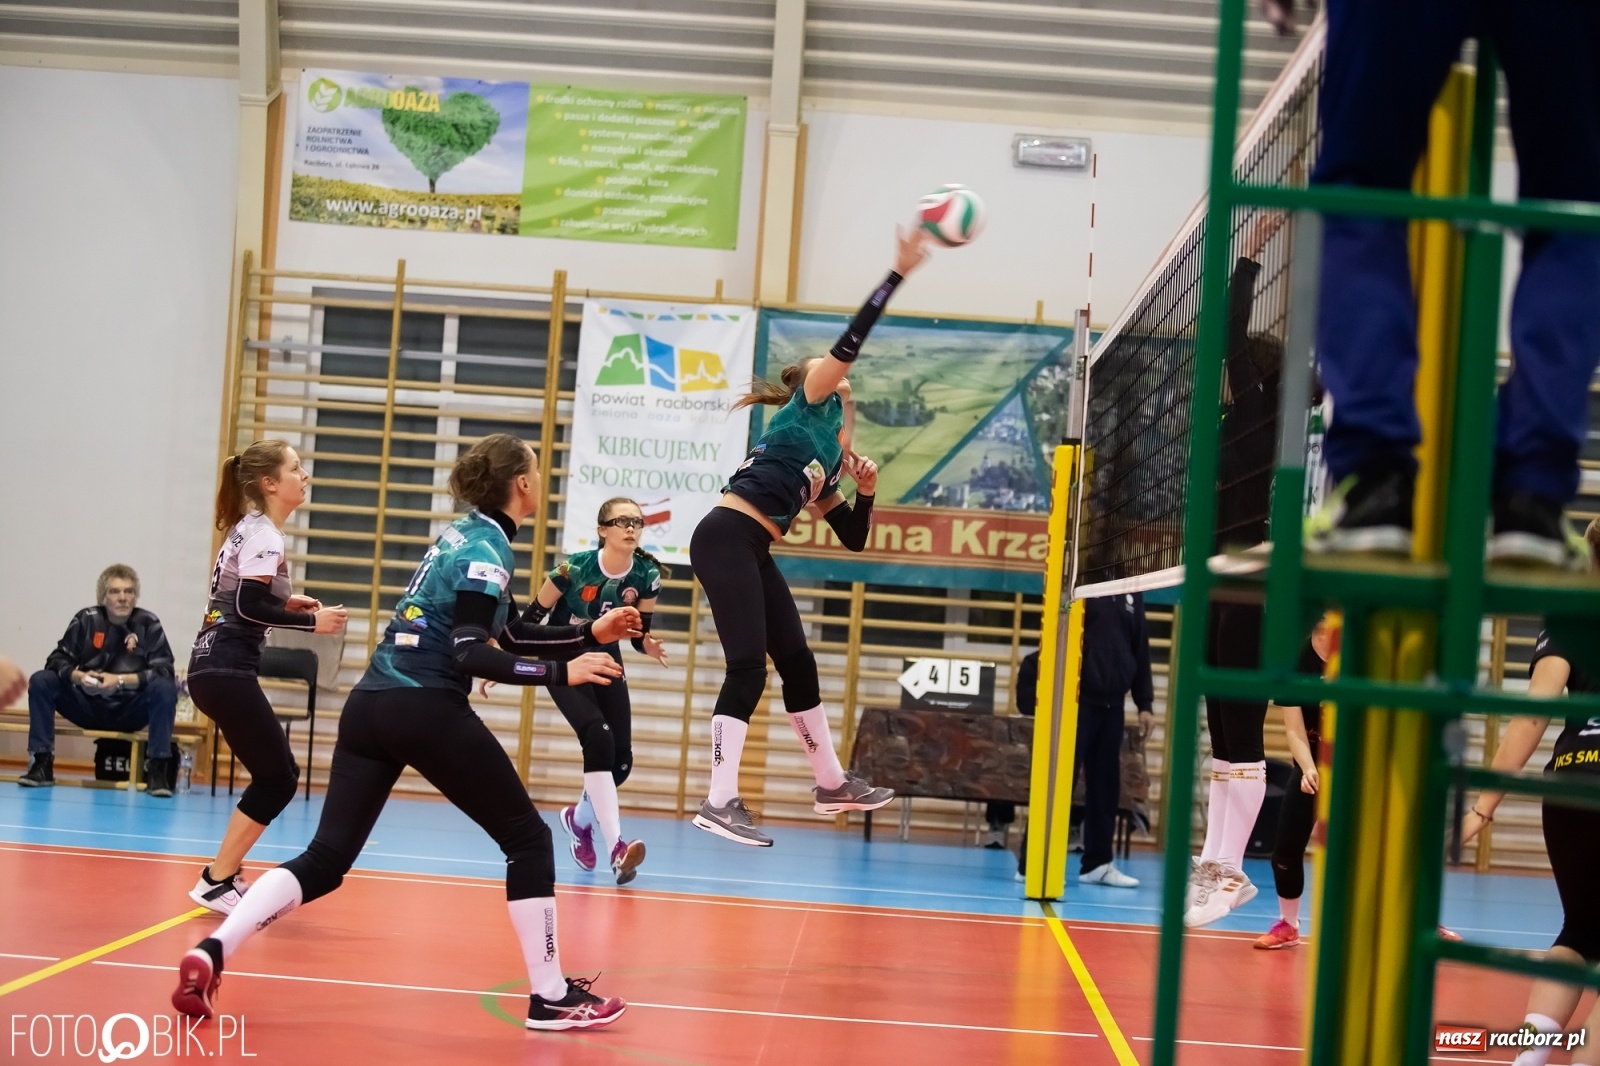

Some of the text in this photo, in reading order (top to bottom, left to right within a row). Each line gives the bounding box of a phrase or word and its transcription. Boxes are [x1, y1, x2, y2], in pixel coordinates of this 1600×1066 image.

[306, 135, 353, 145] ROLNICTWA
[326, 198, 482, 223] www.agrooaza.pl
[591, 392, 730, 412] powiat raciborski
[598, 435, 722, 463] KIBICUJEMY
[929, 665, 970, 687] 4 5
[1575, 750, 1600, 763] SM
